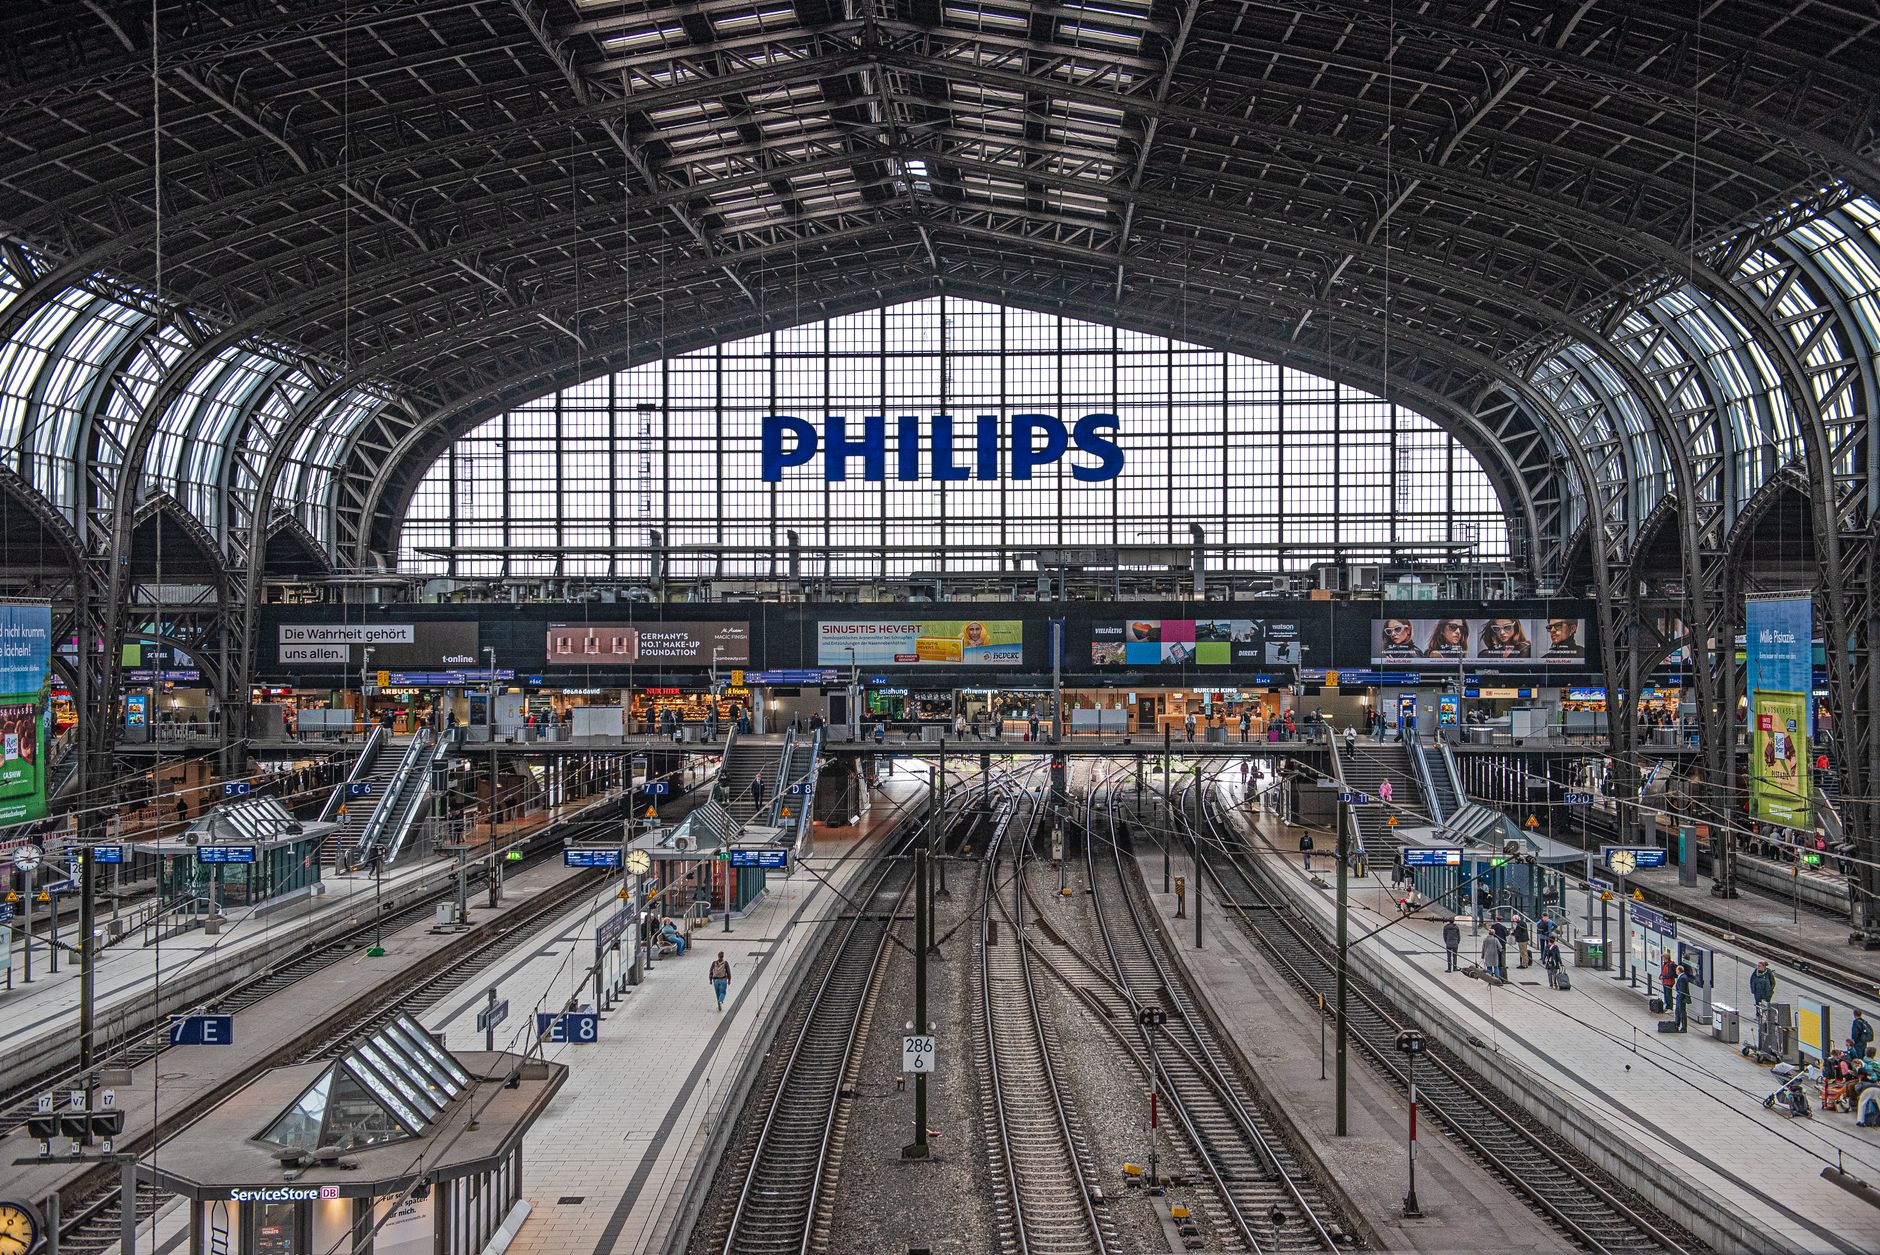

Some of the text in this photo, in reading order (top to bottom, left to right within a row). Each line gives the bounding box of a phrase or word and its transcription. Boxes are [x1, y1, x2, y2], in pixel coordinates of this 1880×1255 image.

[762, 413, 1124, 482] PHILIPS
[4, 623, 20, 638] nicht
[21, 624, 46, 640] krumm,
[822, 624, 922, 634] SINUSITIS HEVERT
[285, 628, 407, 642] Die Wahrheit gehört
[641, 632, 689, 640] GERMANY'S
[4, 642, 31, 656] lächeln!
[663, 640, 700, 648] MAKE-UP
[285, 648, 344, 659] uns allen.
[442, 654, 476, 663] t-online.
[225, 784, 245, 794] 5 C
[351, 784, 371, 794] C 6
[645, 783, 664, 793] 7 D
[792, 784, 812, 794] D 8
[1344, 793, 1368, 803] D 11
[1566, 794, 1577, 804] 12
[173, 1020, 218, 1042] 7 E
[550, 1018, 595, 1039] E 8
[905, 1038, 933, 1053] 286
[914, 1054, 924, 1068] 6
[40, 1097, 52, 1107] r7
[72, 1096, 85, 1106] v7
[103, 1095, 114, 1105] t7
[230, 1187, 337, 1201] ServiceStore DB
[398, 1207, 417, 1217] mich.
